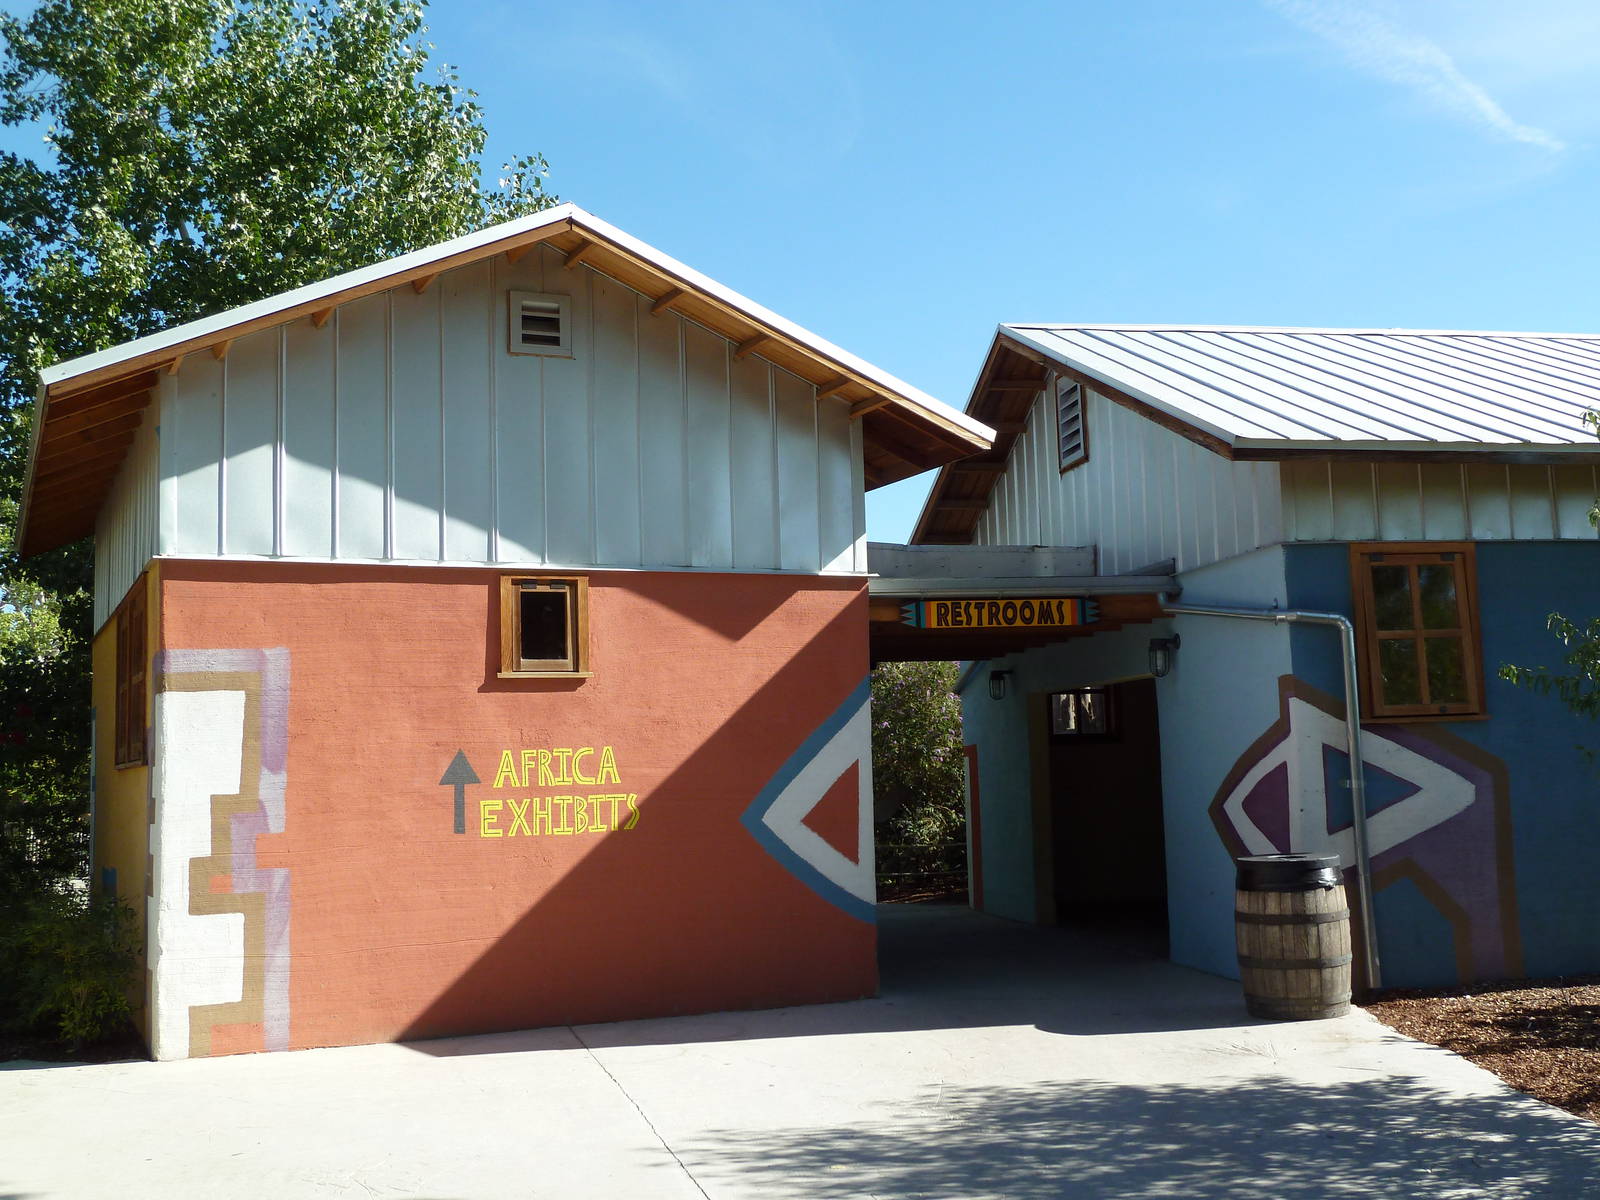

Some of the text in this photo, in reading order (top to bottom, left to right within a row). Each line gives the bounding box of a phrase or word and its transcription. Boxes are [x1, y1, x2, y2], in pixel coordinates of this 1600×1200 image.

[936, 601, 1065, 627] RESTROOMS
[493, 746, 621, 788] AFRICA
[479, 793, 641, 837] EXHIBITS
